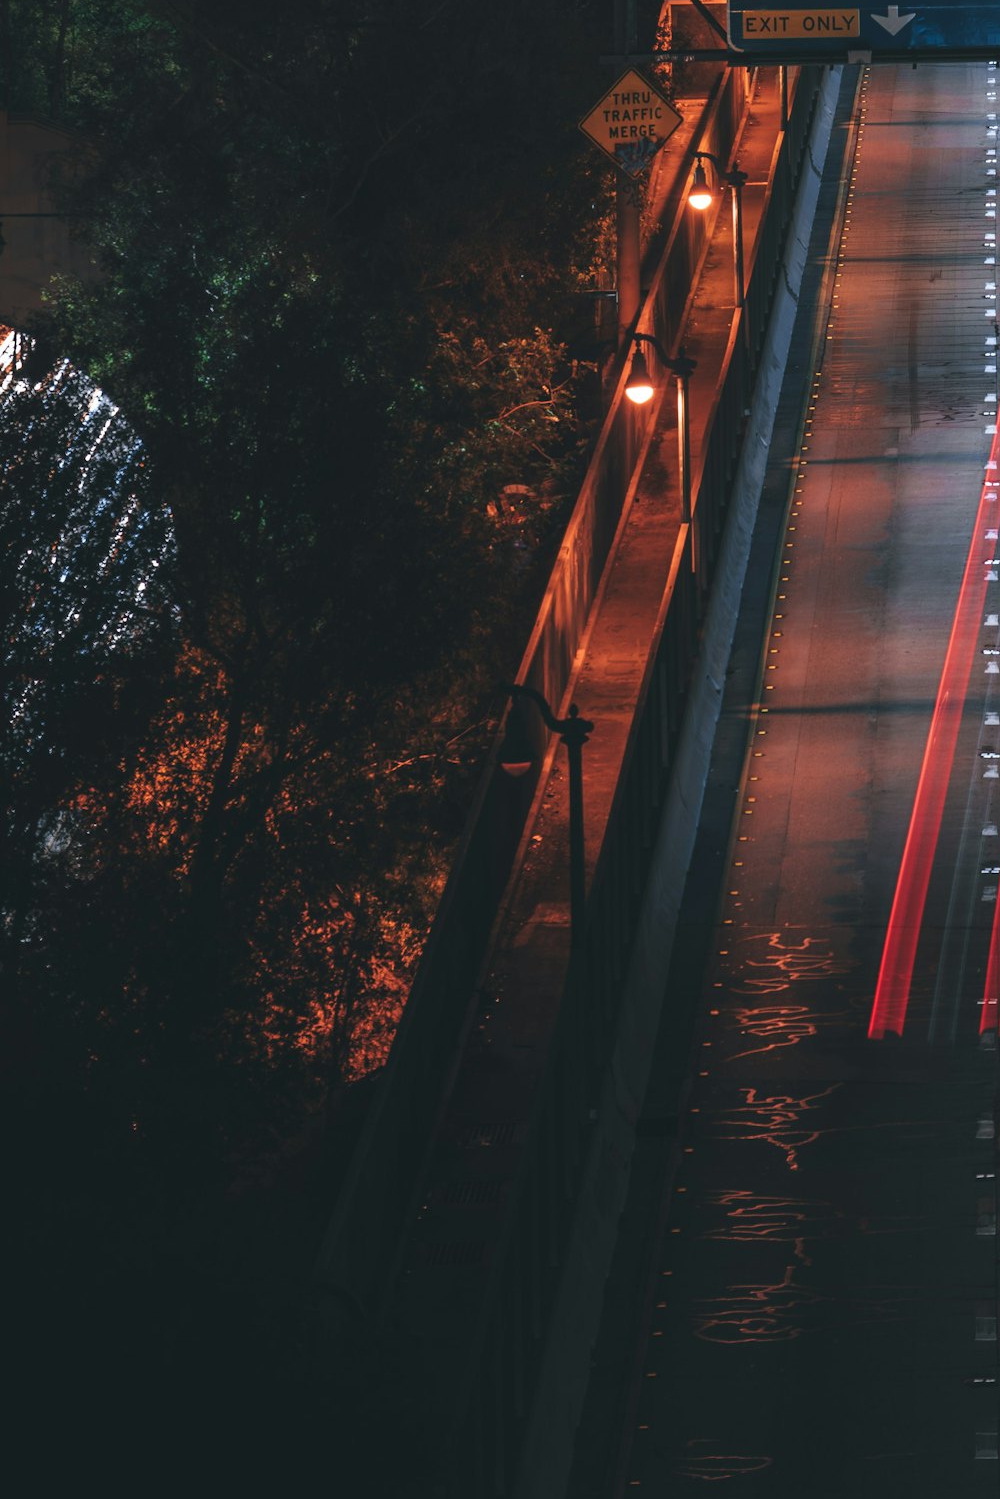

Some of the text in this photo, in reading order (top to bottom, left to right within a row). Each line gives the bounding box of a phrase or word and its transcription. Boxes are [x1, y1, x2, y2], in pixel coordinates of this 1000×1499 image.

[745, 14, 855, 32] EXIT ONLY
[613, 92, 650, 105] THRU
[603, 107, 662, 122] TRAFFIC
[609, 124, 656, 139] MERGE
